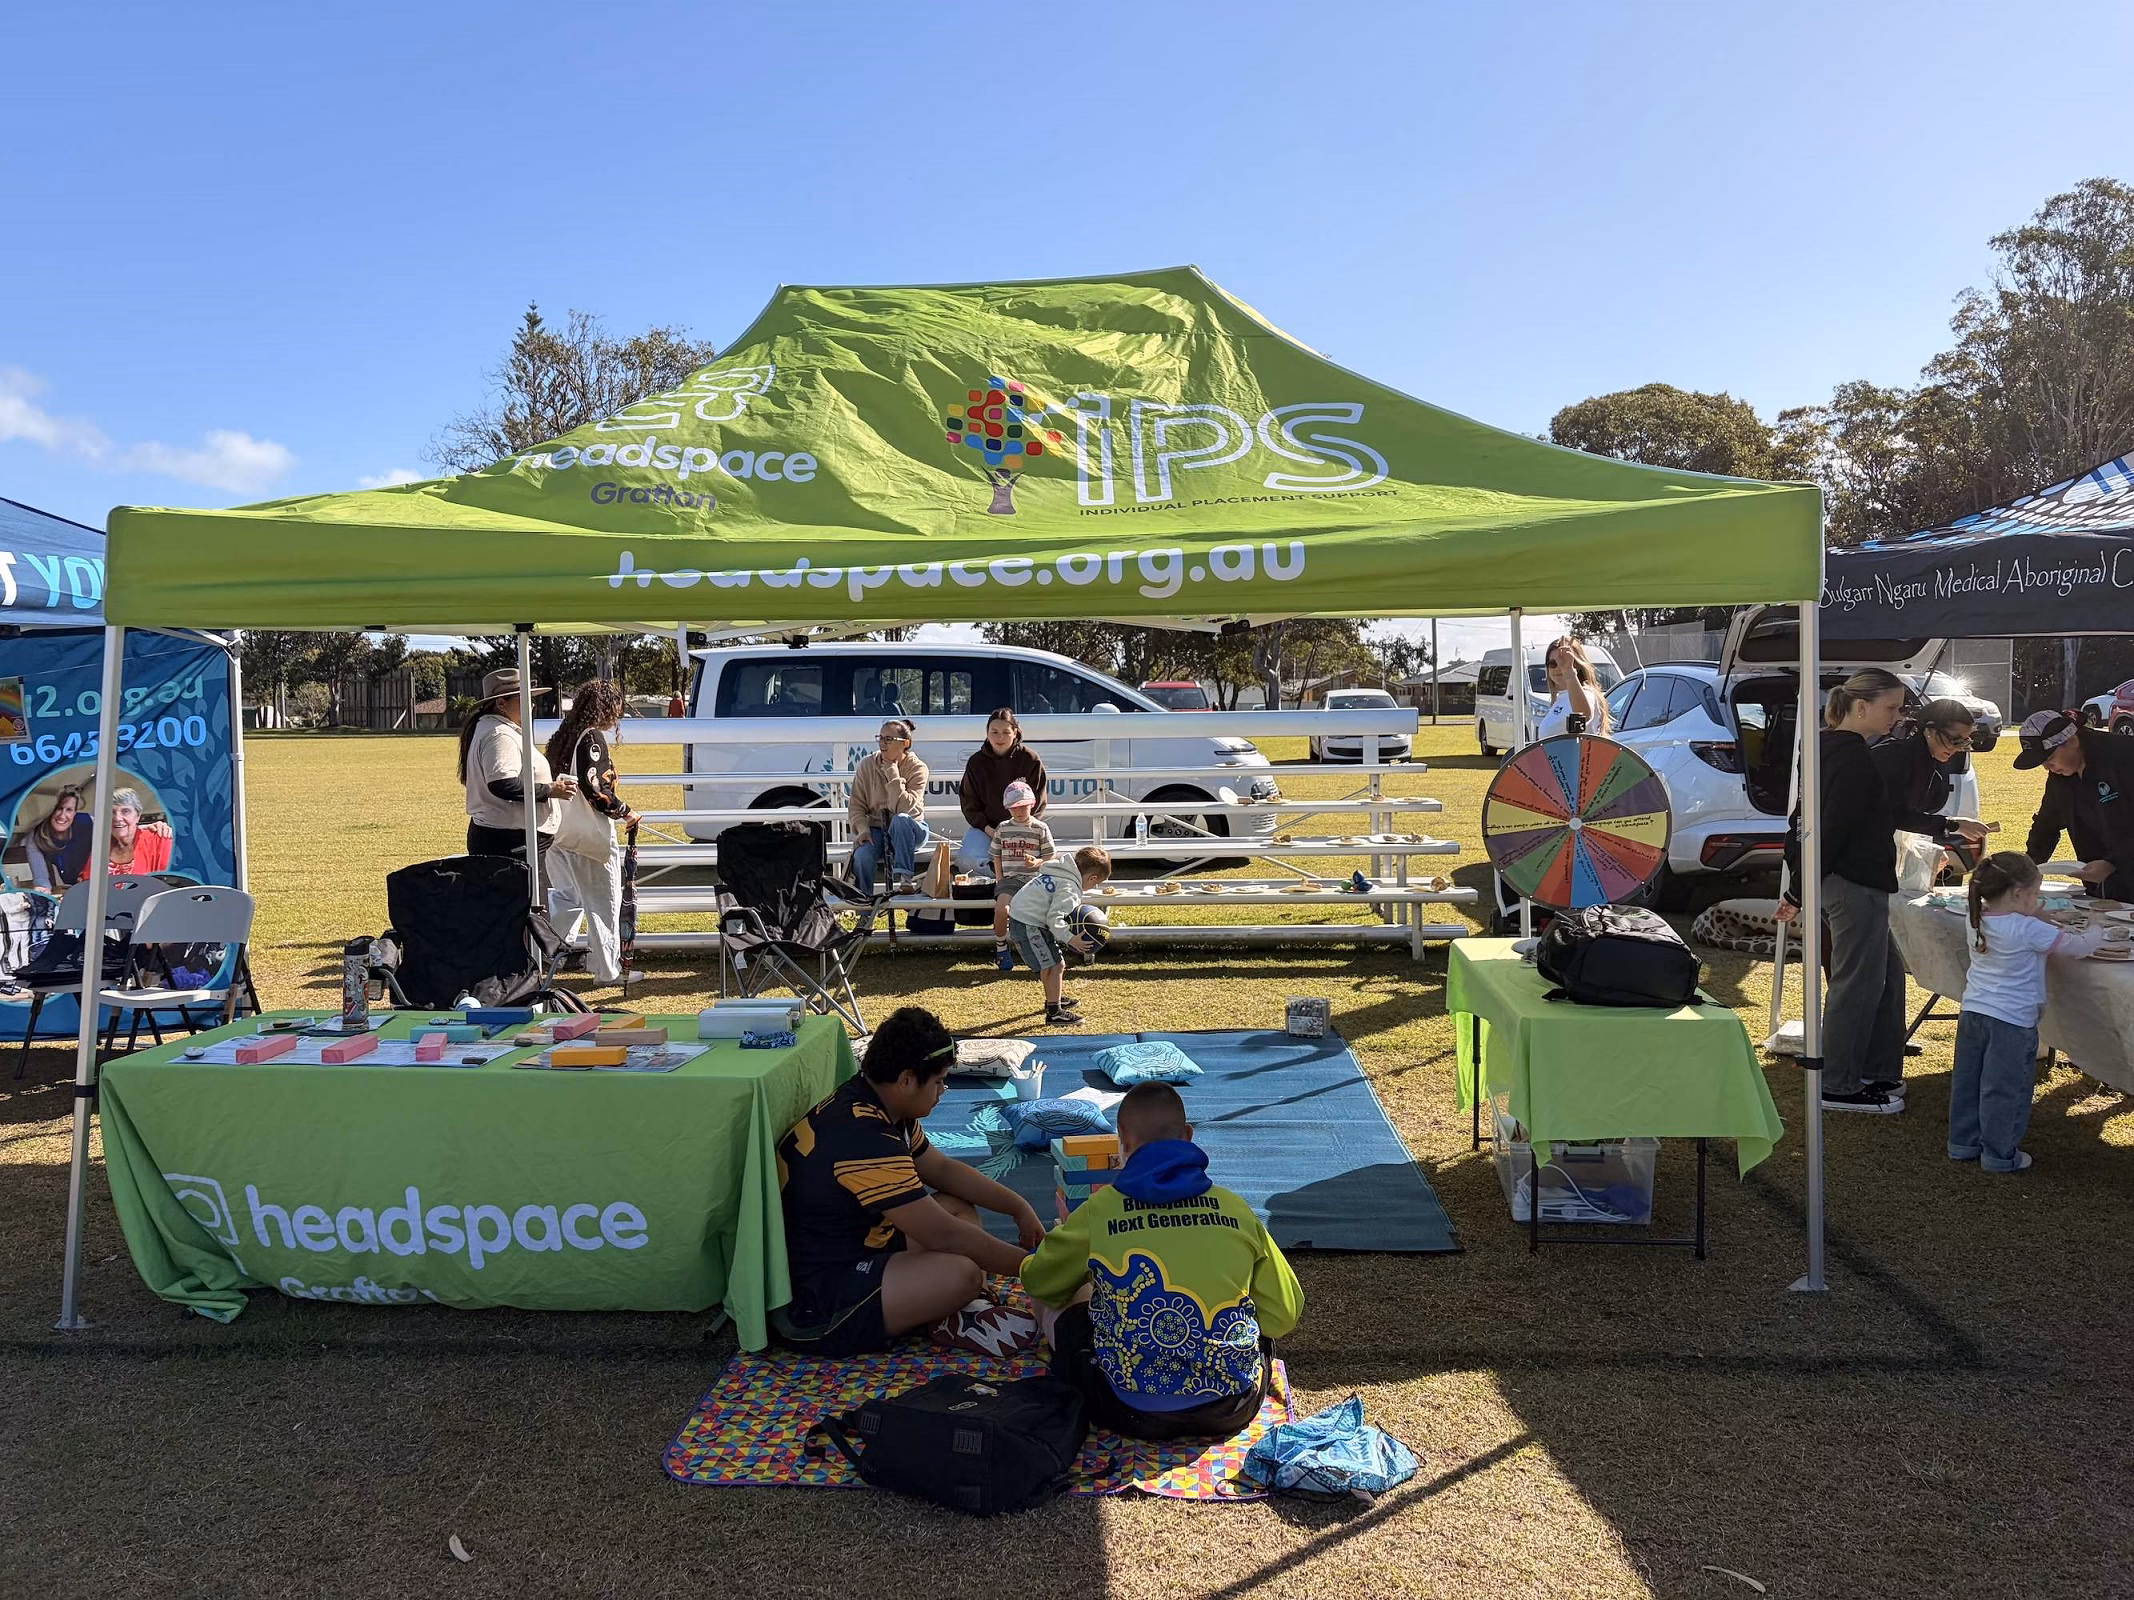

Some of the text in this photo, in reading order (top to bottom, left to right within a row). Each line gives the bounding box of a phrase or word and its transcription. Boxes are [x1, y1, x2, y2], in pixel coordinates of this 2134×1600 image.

[591, 482, 716, 511] Grafton
[1080, 489, 1399, 516] INDIVIDUAL PLACEMENT SUPPORT
[22, 553, 104, 609] YO
[608, 540, 1306, 602] headspace.org.au
[1874, 572, 1926, 609] Ngaru
[1934, 560, 2001, 599] Medical
[2002, 550, 2106, 596] Aboriginal
[25, 674, 204, 718] 2.og.au
[245, 1184, 649, 1269] headspace
[1107, 1212, 1240, 1235] Next Generation
